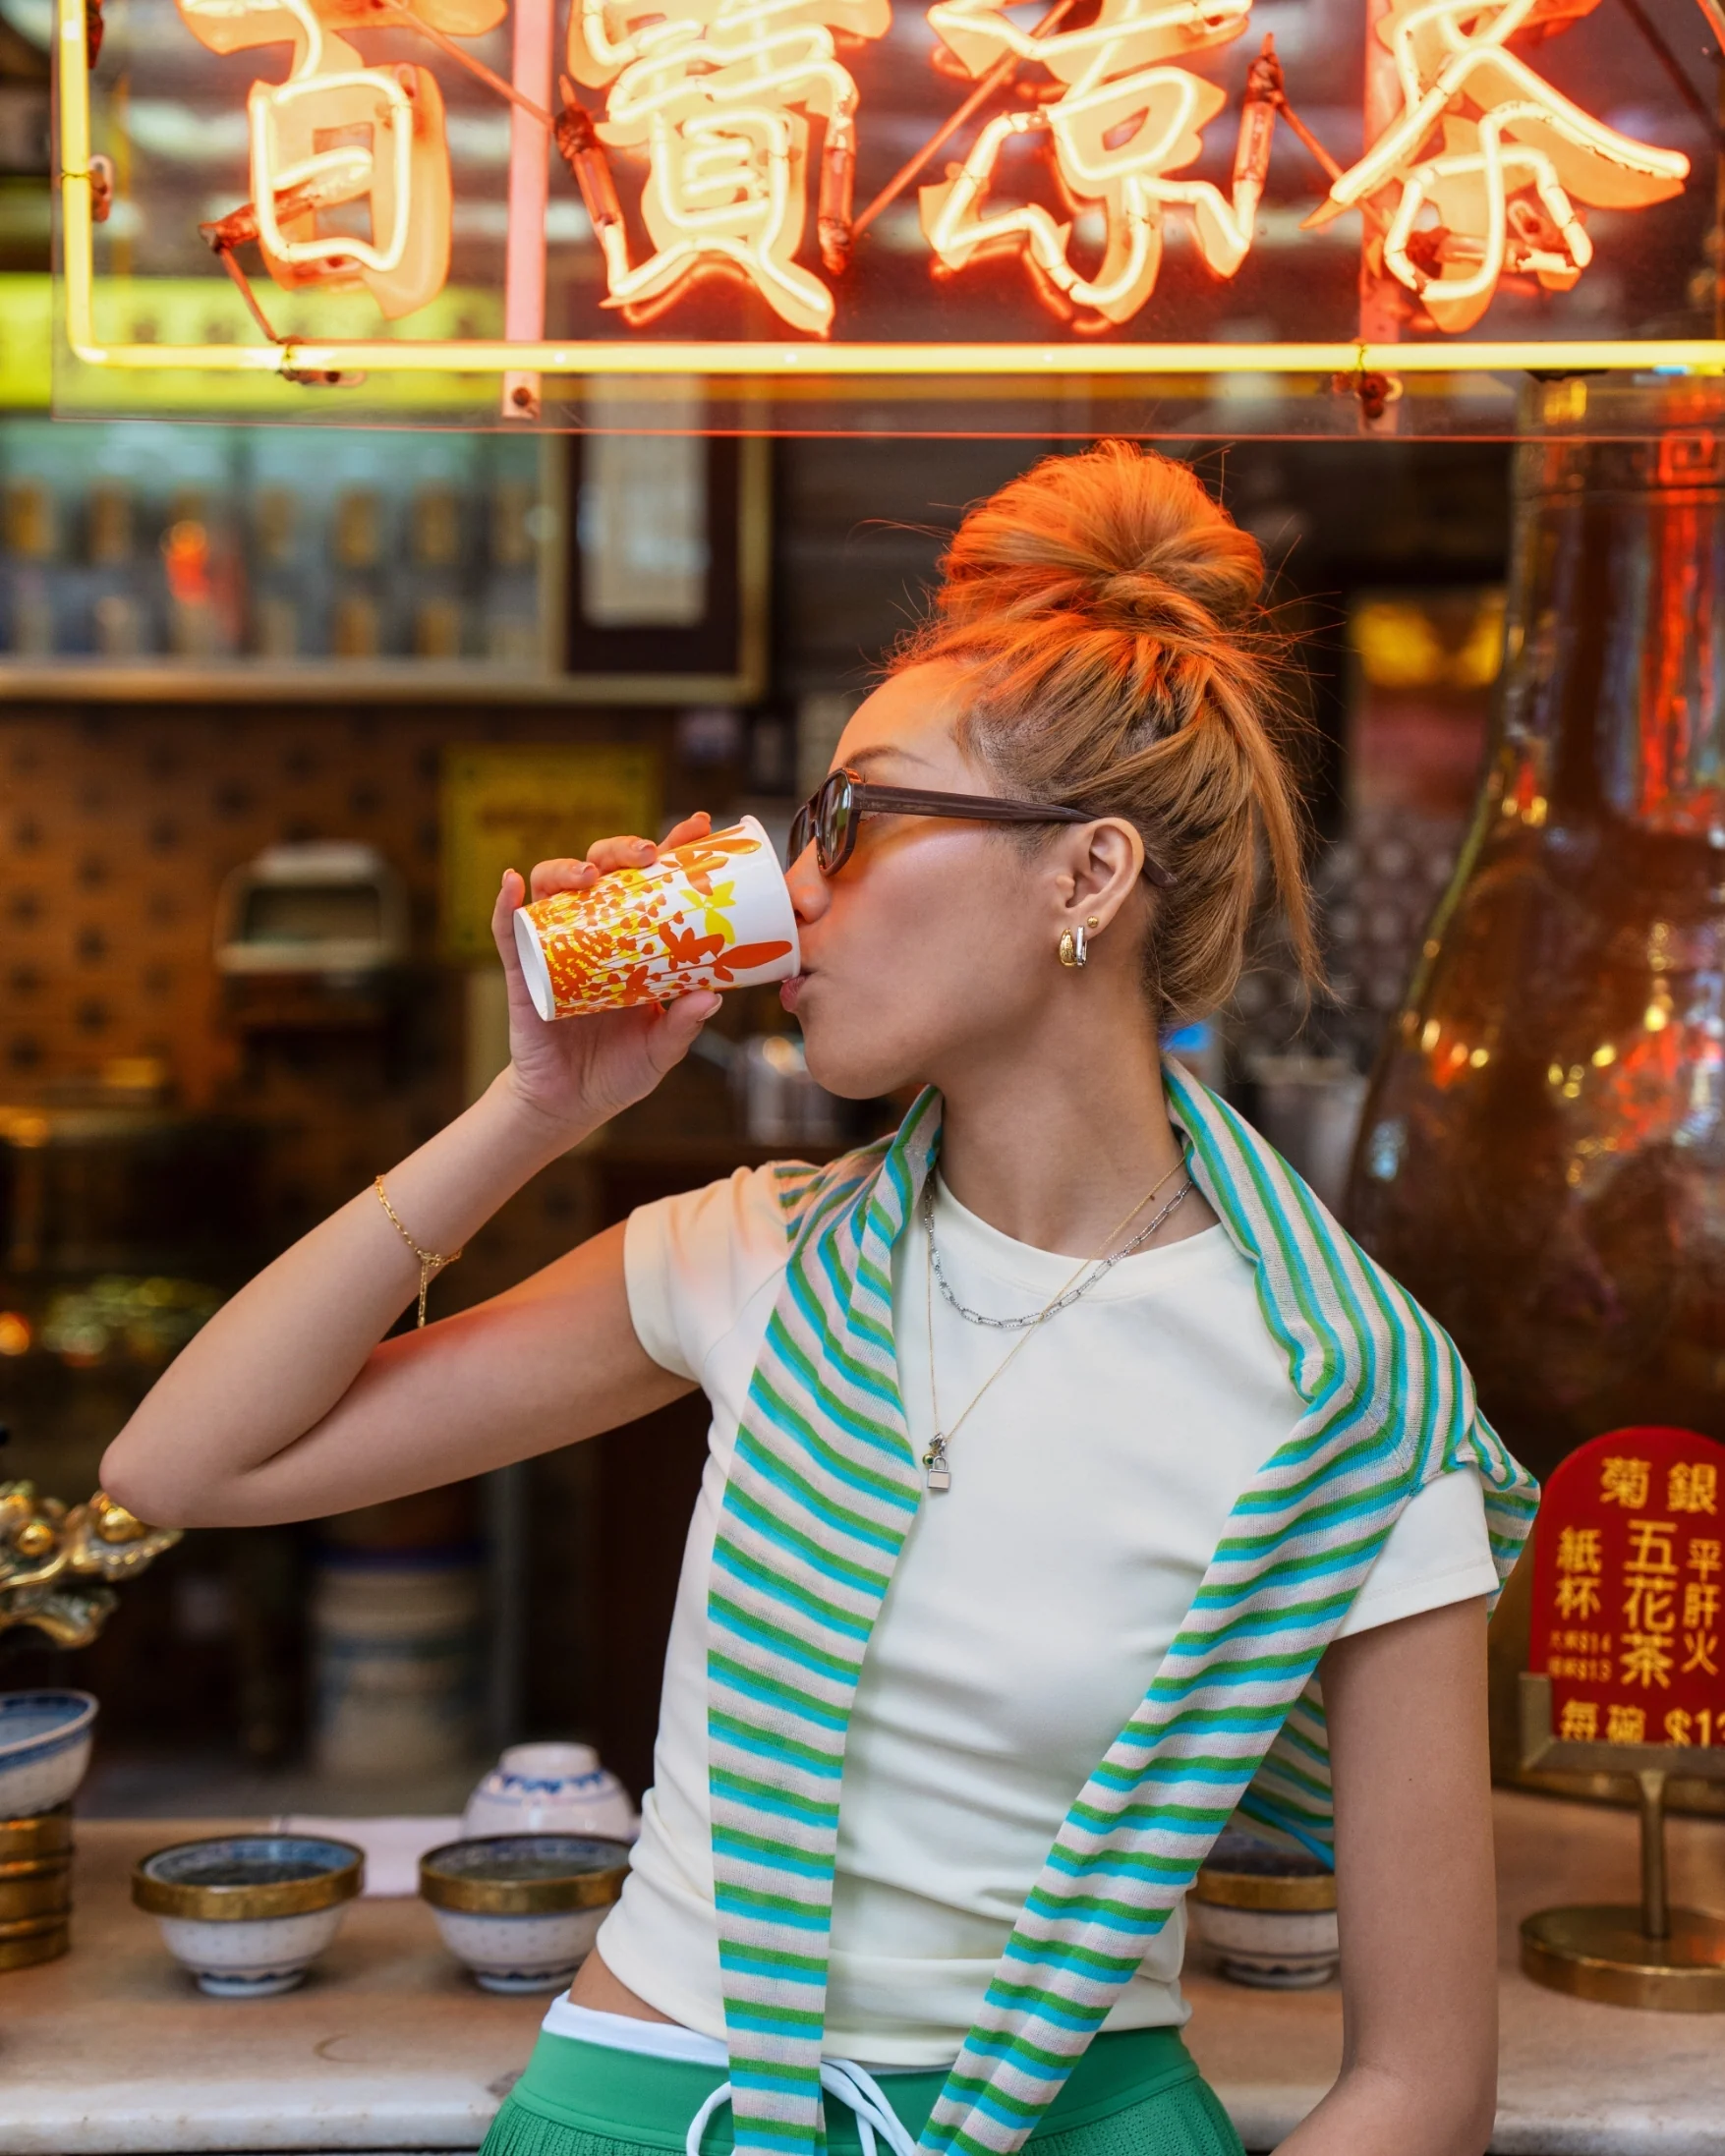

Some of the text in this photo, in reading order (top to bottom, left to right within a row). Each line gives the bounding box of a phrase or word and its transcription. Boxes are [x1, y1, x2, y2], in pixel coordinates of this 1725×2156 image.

[1555, 1525, 1602, 1619] 紙杯
[1620, 1519, 1679, 1688] 五花茶
[1681, 1538, 1722, 1675] 平肝火
[1664, 1707, 1725, 1748] $1
